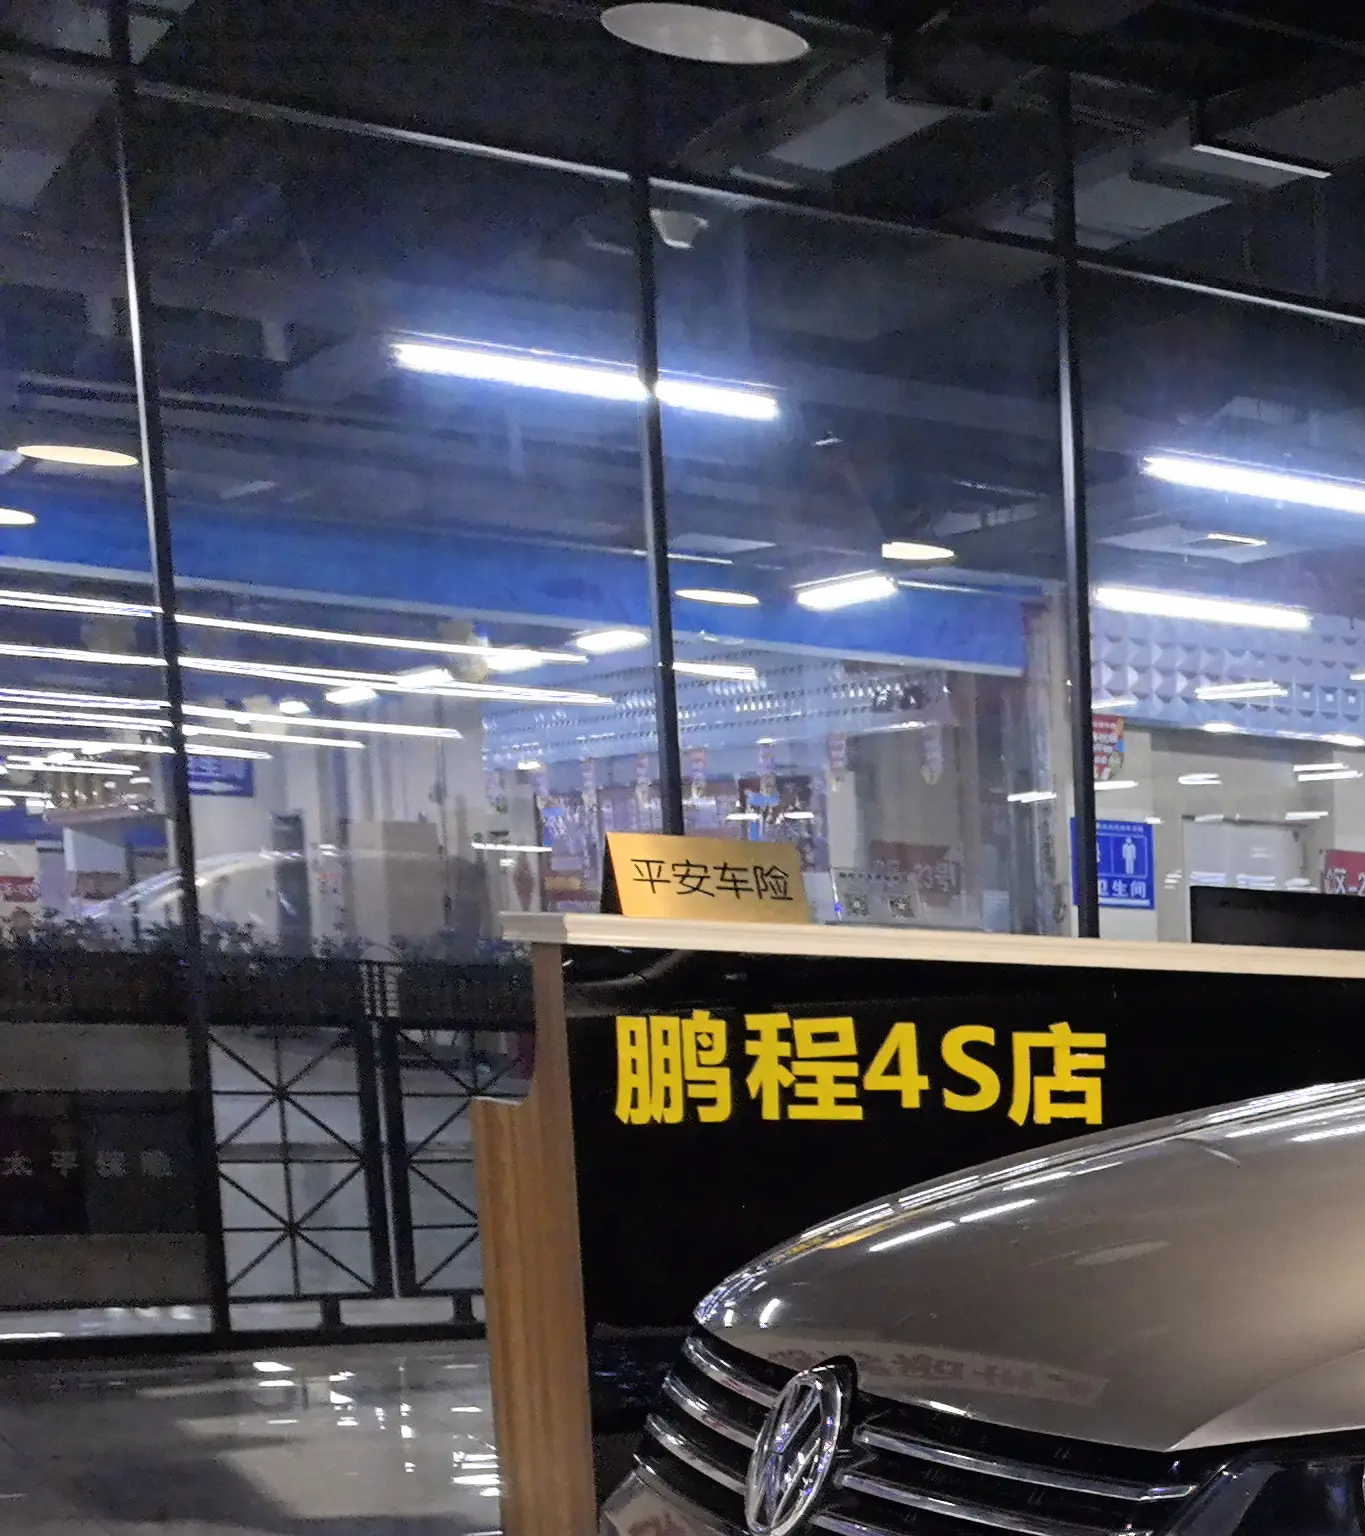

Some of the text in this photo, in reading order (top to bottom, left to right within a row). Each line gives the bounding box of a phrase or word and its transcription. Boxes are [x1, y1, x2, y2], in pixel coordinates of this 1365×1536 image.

[630, 859, 794, 901] 平安车险
[615, 1009, 1107, 1125] 鹏程4S店
